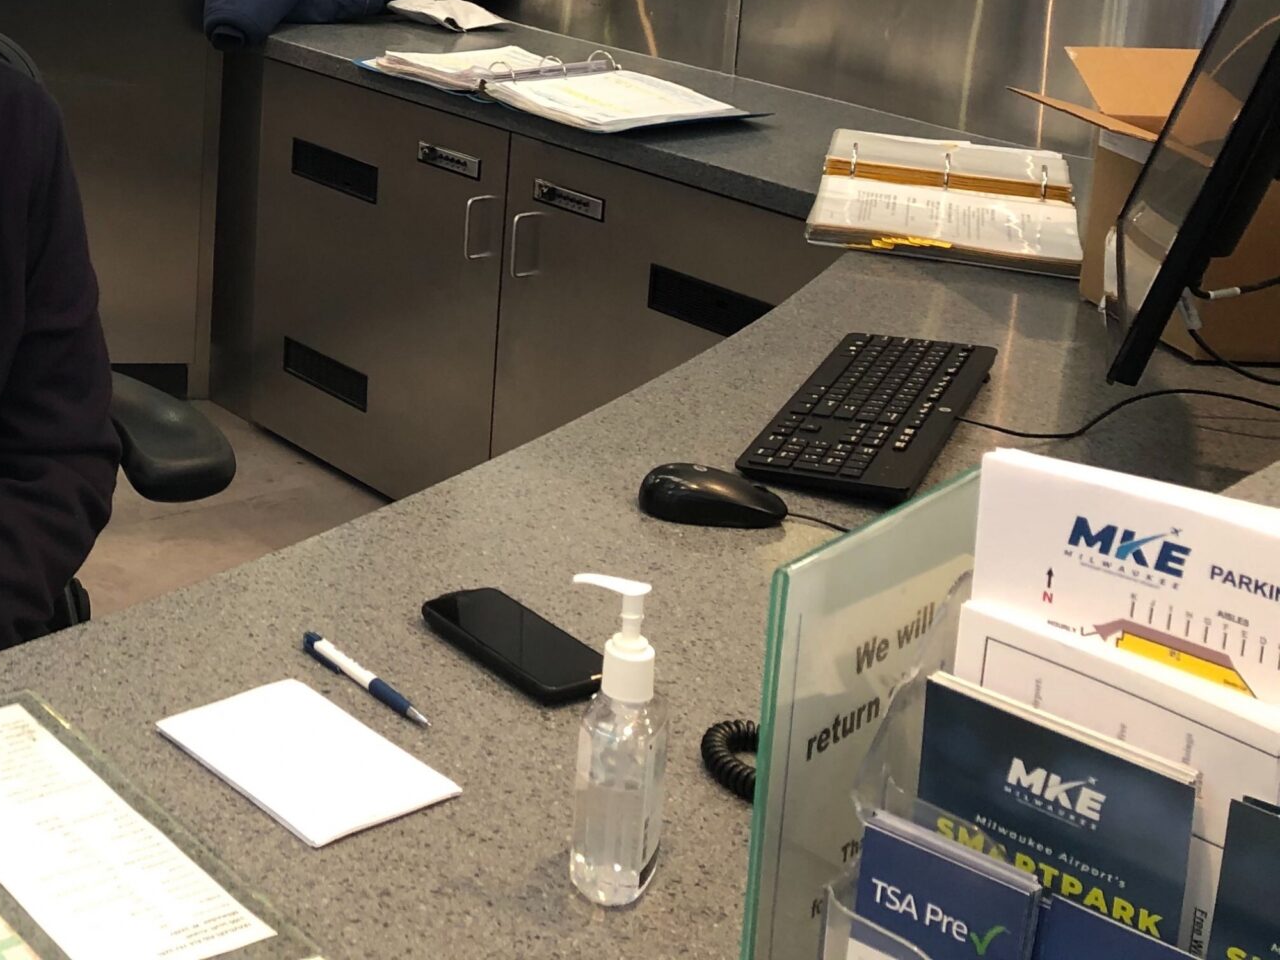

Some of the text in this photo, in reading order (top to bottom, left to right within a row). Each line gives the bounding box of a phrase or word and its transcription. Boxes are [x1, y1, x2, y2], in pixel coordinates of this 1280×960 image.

[1063, 548, 1181, 591] MILWAUKEE
[1067, 515, 1192, 579] MKE
[1042, 591, 1053, 604] N
[1217, 610, 1250, 627] AISLES
[856, 602, 935, 675] We will
[806, 696, 880, 762] return
[1004, 785, 1096, 831] MILWAUKEE
[1006, 757, 1107, 822] MKE
[975, 813, 1053, 856] Milwaukee
[1058, 851, 1127, 889] Airport's
[871, 877, 918, 921] TSA
[924, 902, 968, 943] Pre
